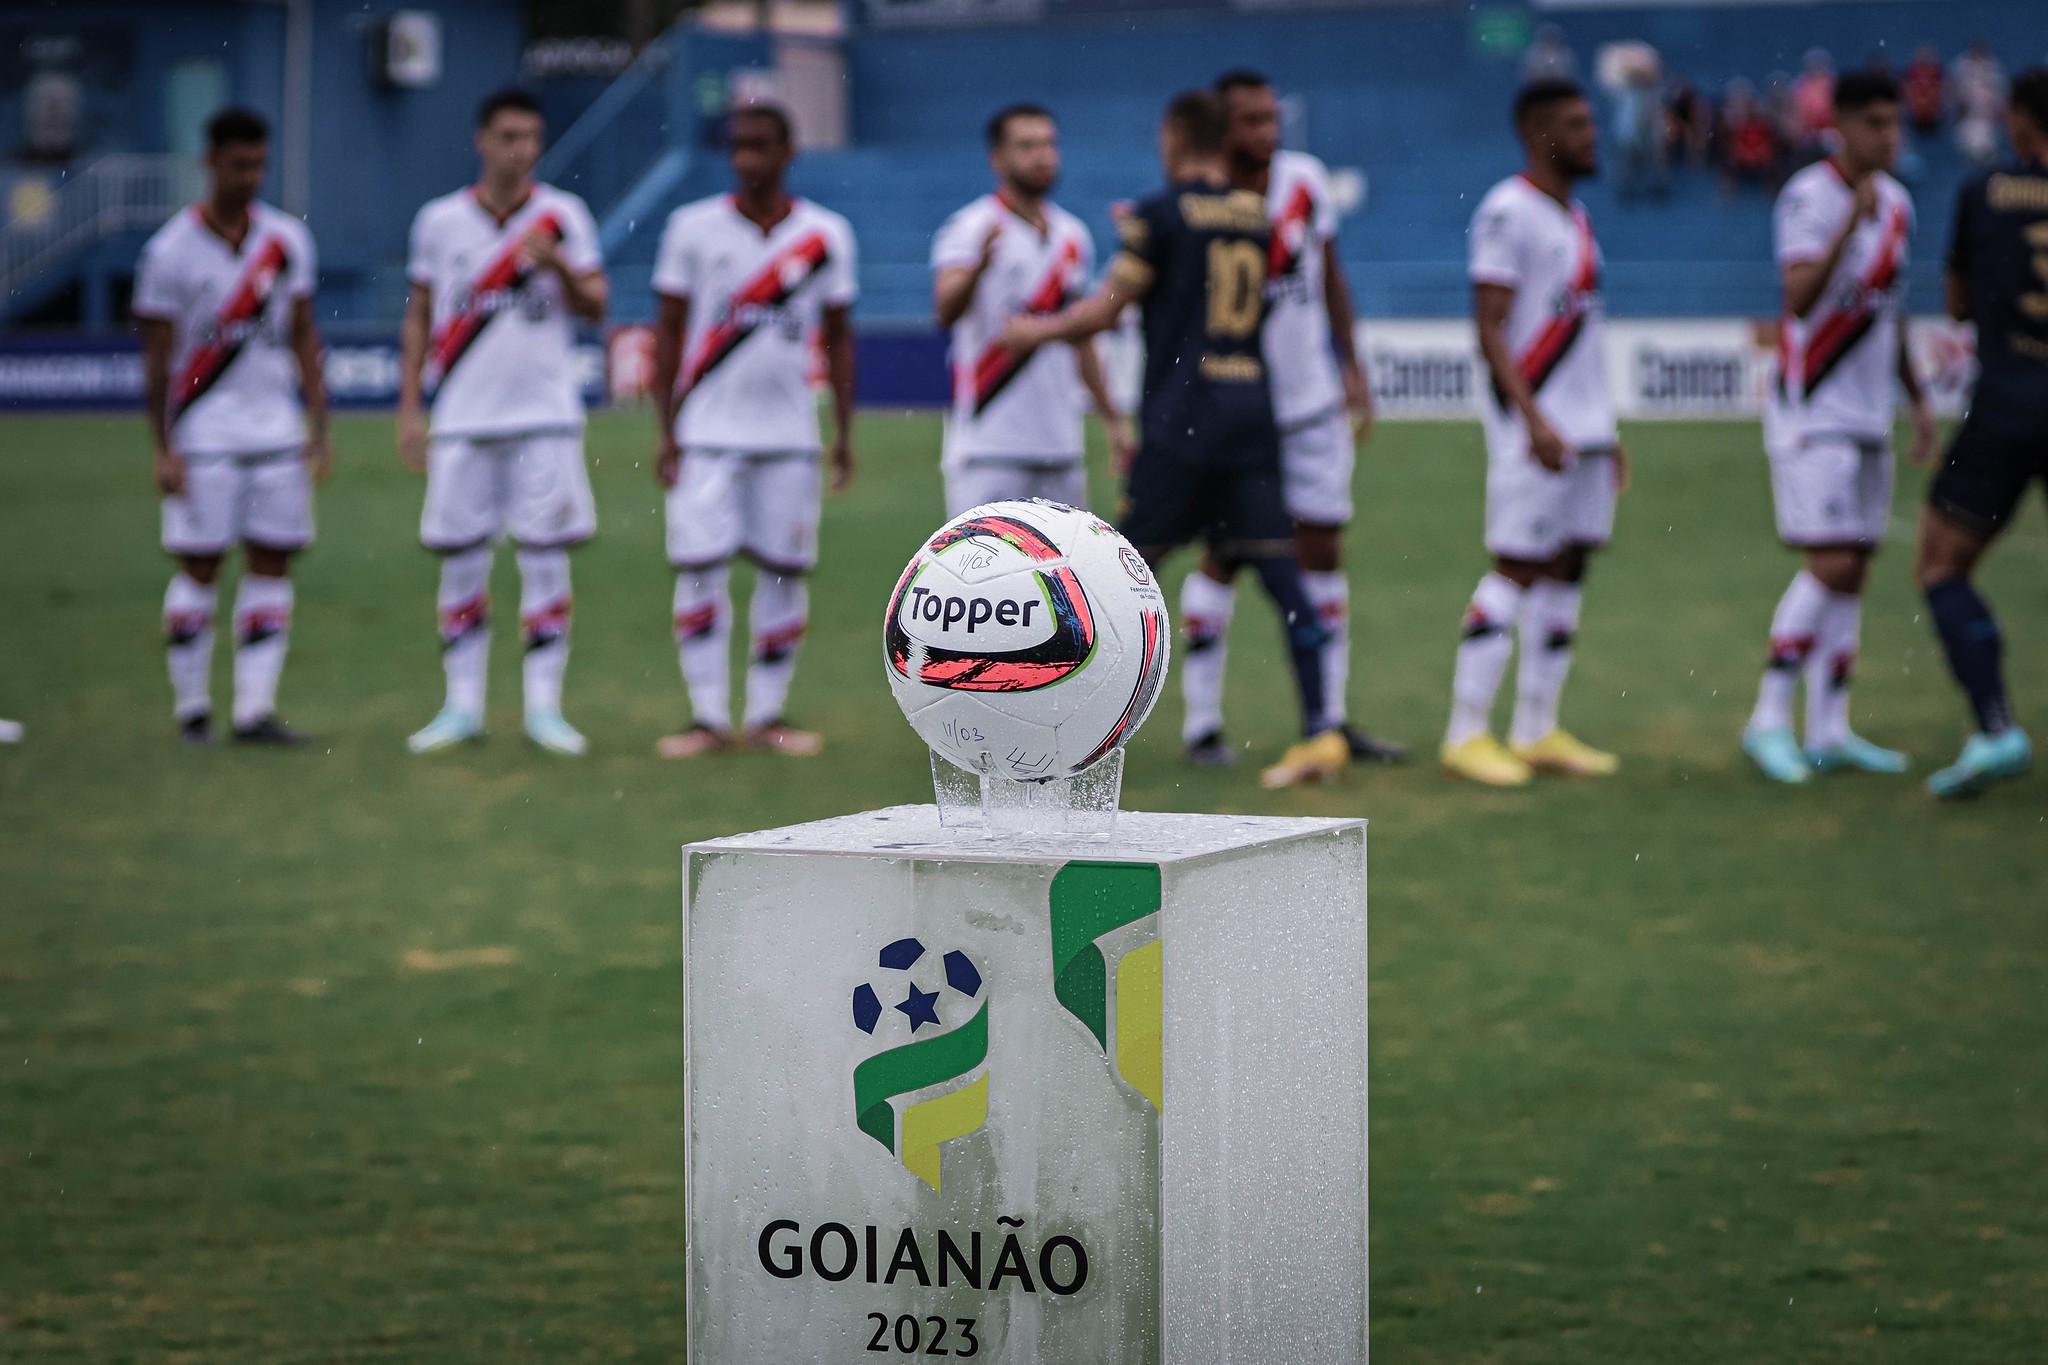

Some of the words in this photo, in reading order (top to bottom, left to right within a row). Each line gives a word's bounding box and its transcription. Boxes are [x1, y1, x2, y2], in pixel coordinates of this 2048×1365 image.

[911, 586, 1041, 634] Topper
[757, 1215, 1089, 1297] GOIANÃO
[866, 1311, 980, 1358] 2023
